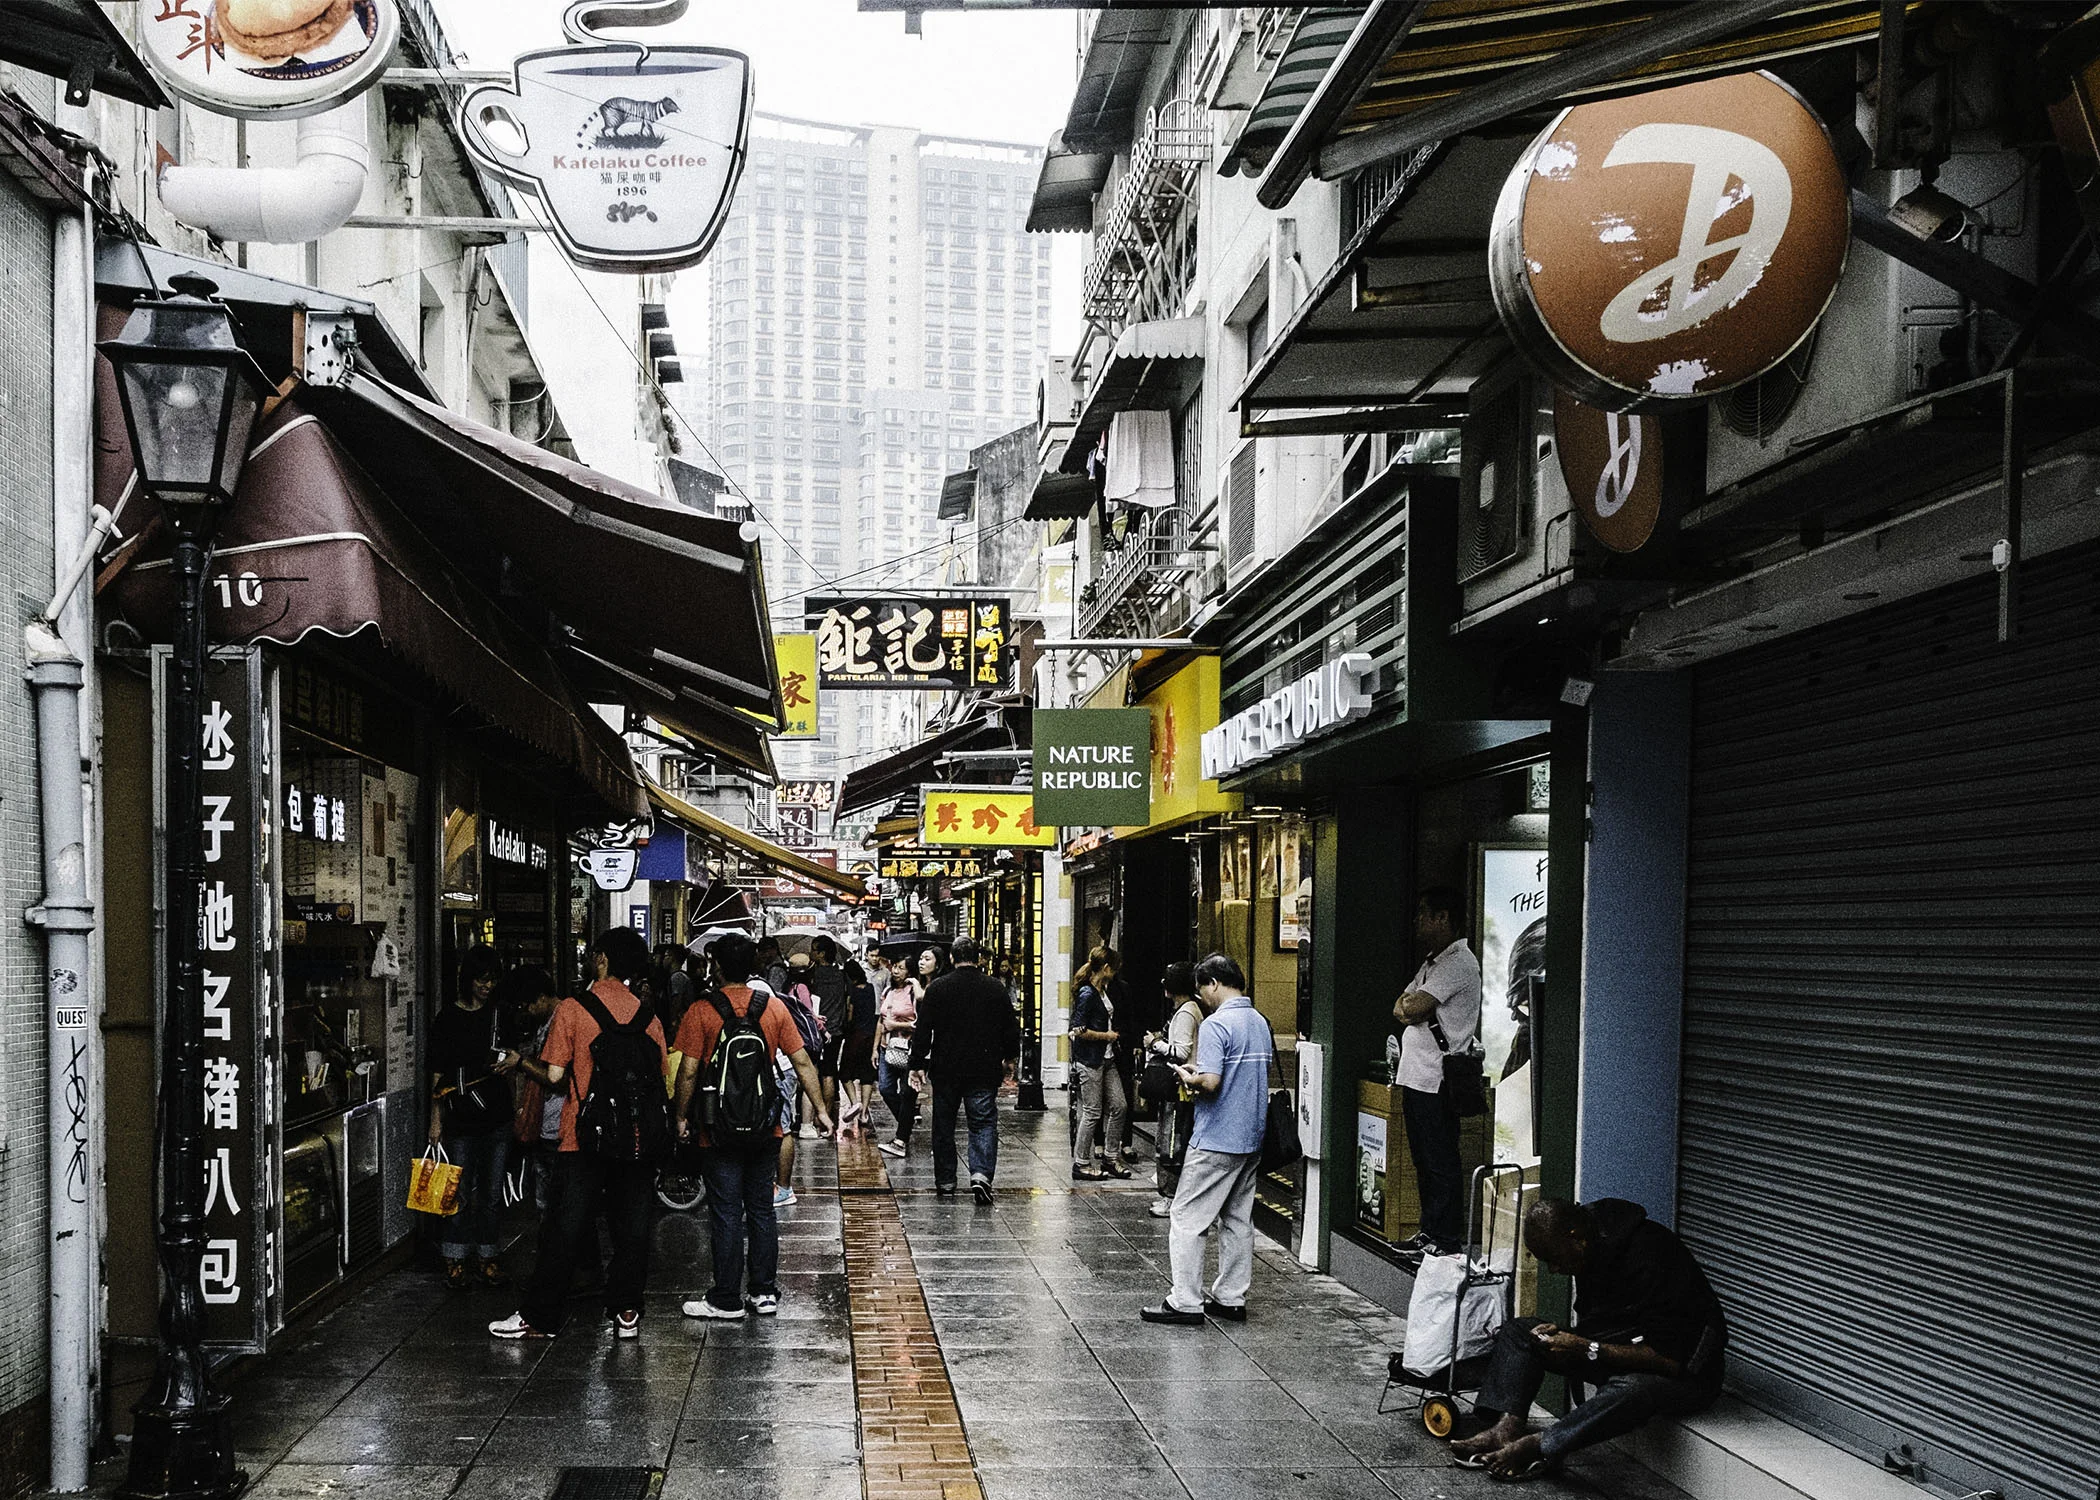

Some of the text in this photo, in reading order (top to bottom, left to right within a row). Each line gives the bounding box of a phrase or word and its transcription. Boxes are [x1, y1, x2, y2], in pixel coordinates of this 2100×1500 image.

[553, 154, 707, 169] Kafelaku Coffee
[617, 186, 647, 196] 1896
[213, 571, 262, 608] 10
[828, 674, 929, 682] PASTELARIA KOI KEI
[780, 671, 812, 709] 家
[1260, 653, 1372, 755] REPUBLIC
[1049, 745, 1135, 764] NATURE
[1041, 771, 1142, 789] REPUBLIC
[281, 784, 303, 833] 包
[489, 819, 526, 864] Kafelaku
[1509, 890, 1545, 913] THE
[301, 912, 333, 922] 味汽水
[57, 1010, 87, 1025] QUEST
